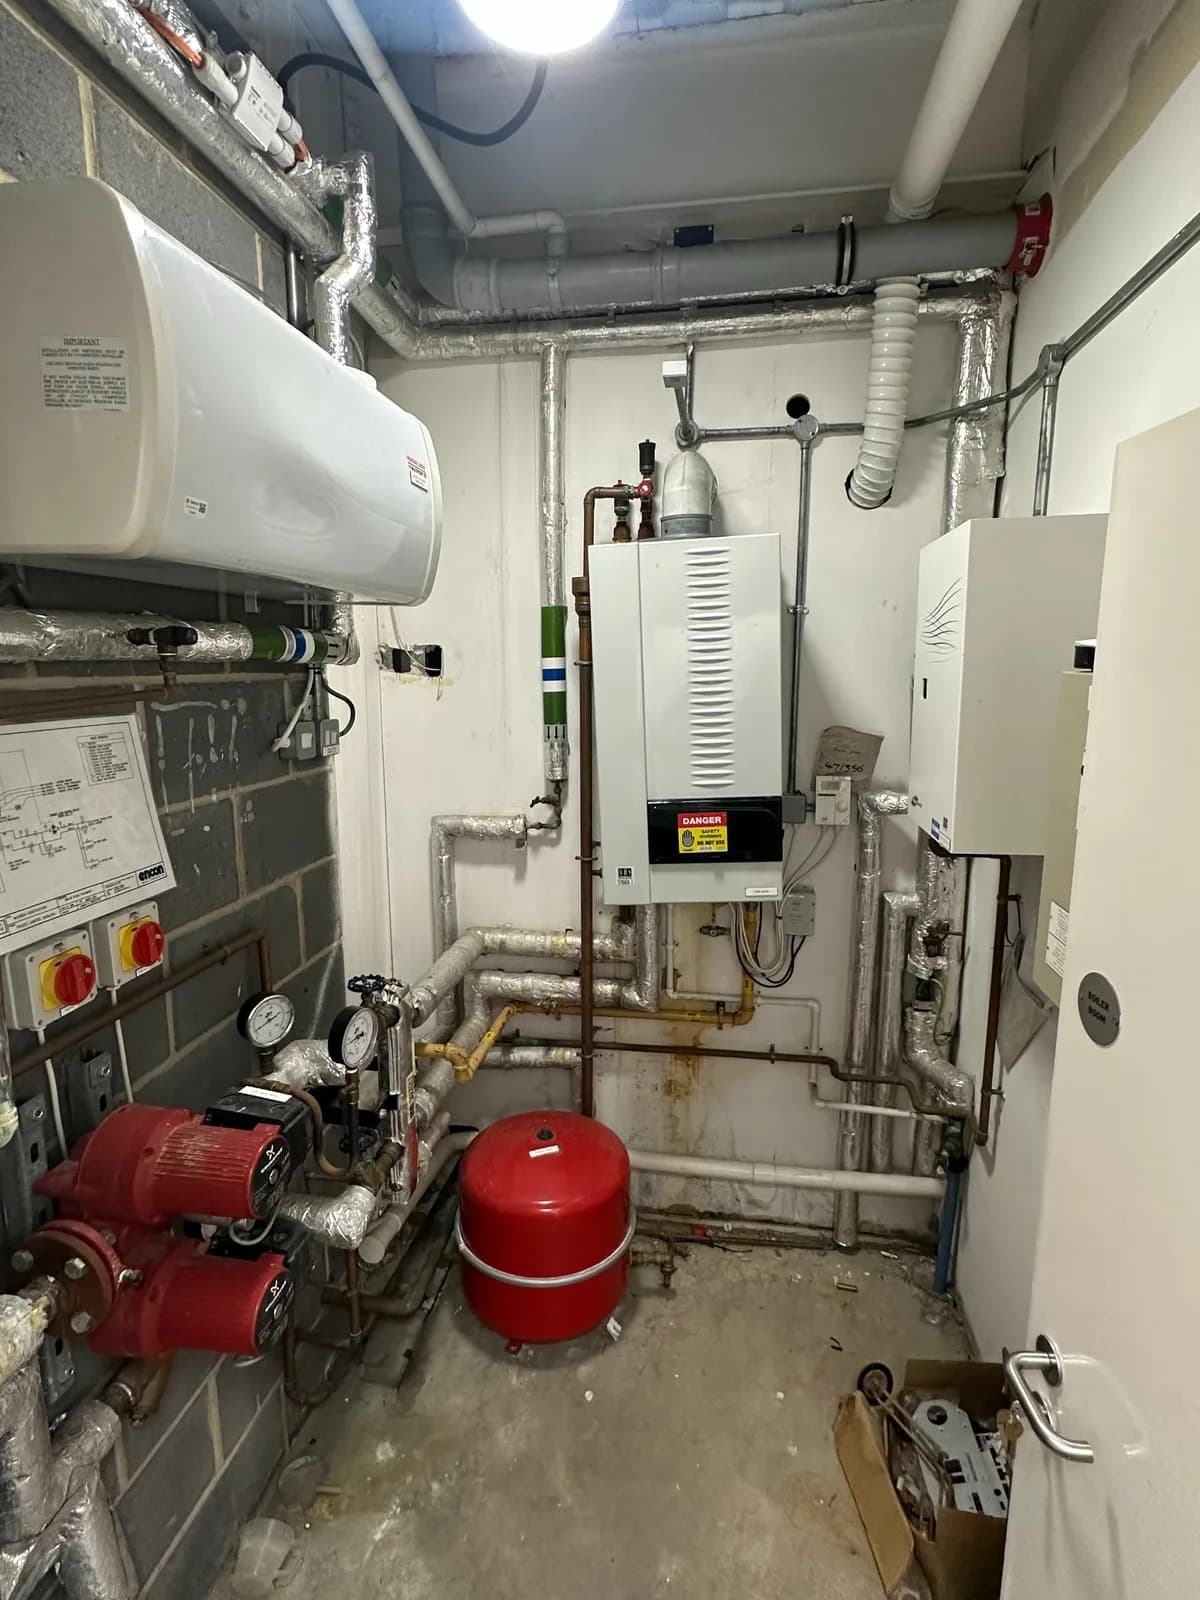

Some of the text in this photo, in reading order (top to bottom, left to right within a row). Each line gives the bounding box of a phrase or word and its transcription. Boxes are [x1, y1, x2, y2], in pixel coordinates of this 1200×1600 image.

[63, 337, 100, 345] IMPORTANT
[682, 816, 722, 825] DANGER
[1087, 991, 1109, 1012] BOILER
[1087, 1005, 1106, 1025] ROOM
